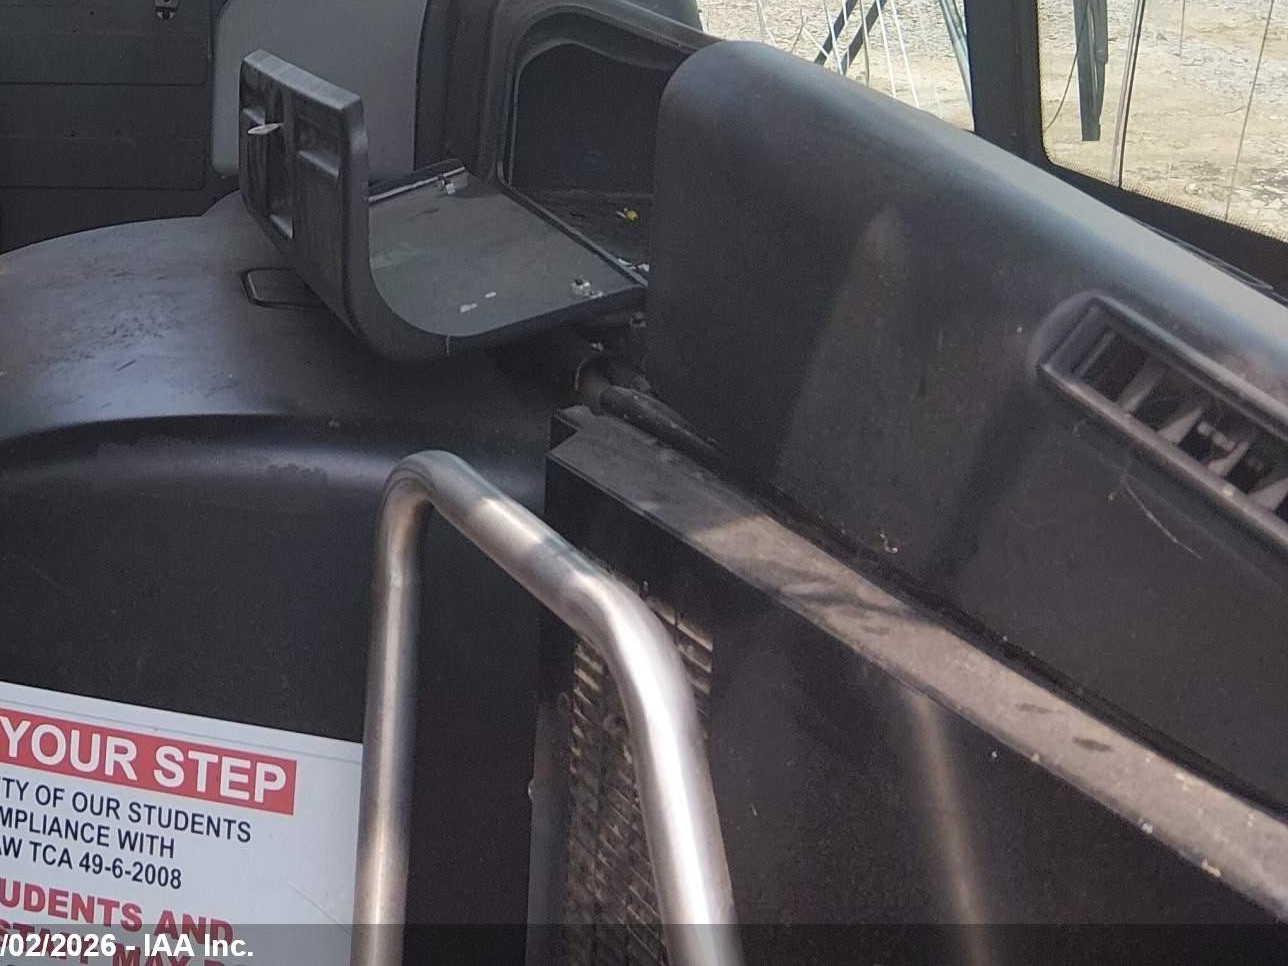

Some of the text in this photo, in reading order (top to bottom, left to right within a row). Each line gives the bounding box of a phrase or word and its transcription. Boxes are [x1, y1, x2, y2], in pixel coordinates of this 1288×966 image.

[0, 715, 138, 781] YOUR
[153, 745, 287, 803] STEP
[35, 784, 65, 808] OF
[72, 791, 121, 820] OUR
[127, 802, 252, 843] STUDENTS
[29, 840, 73, 869] TCA
[78, 851, 182, 890] 49-6-2008
[117, 828, 175, 859] WITH
[154, 910, 234, 947] AND
